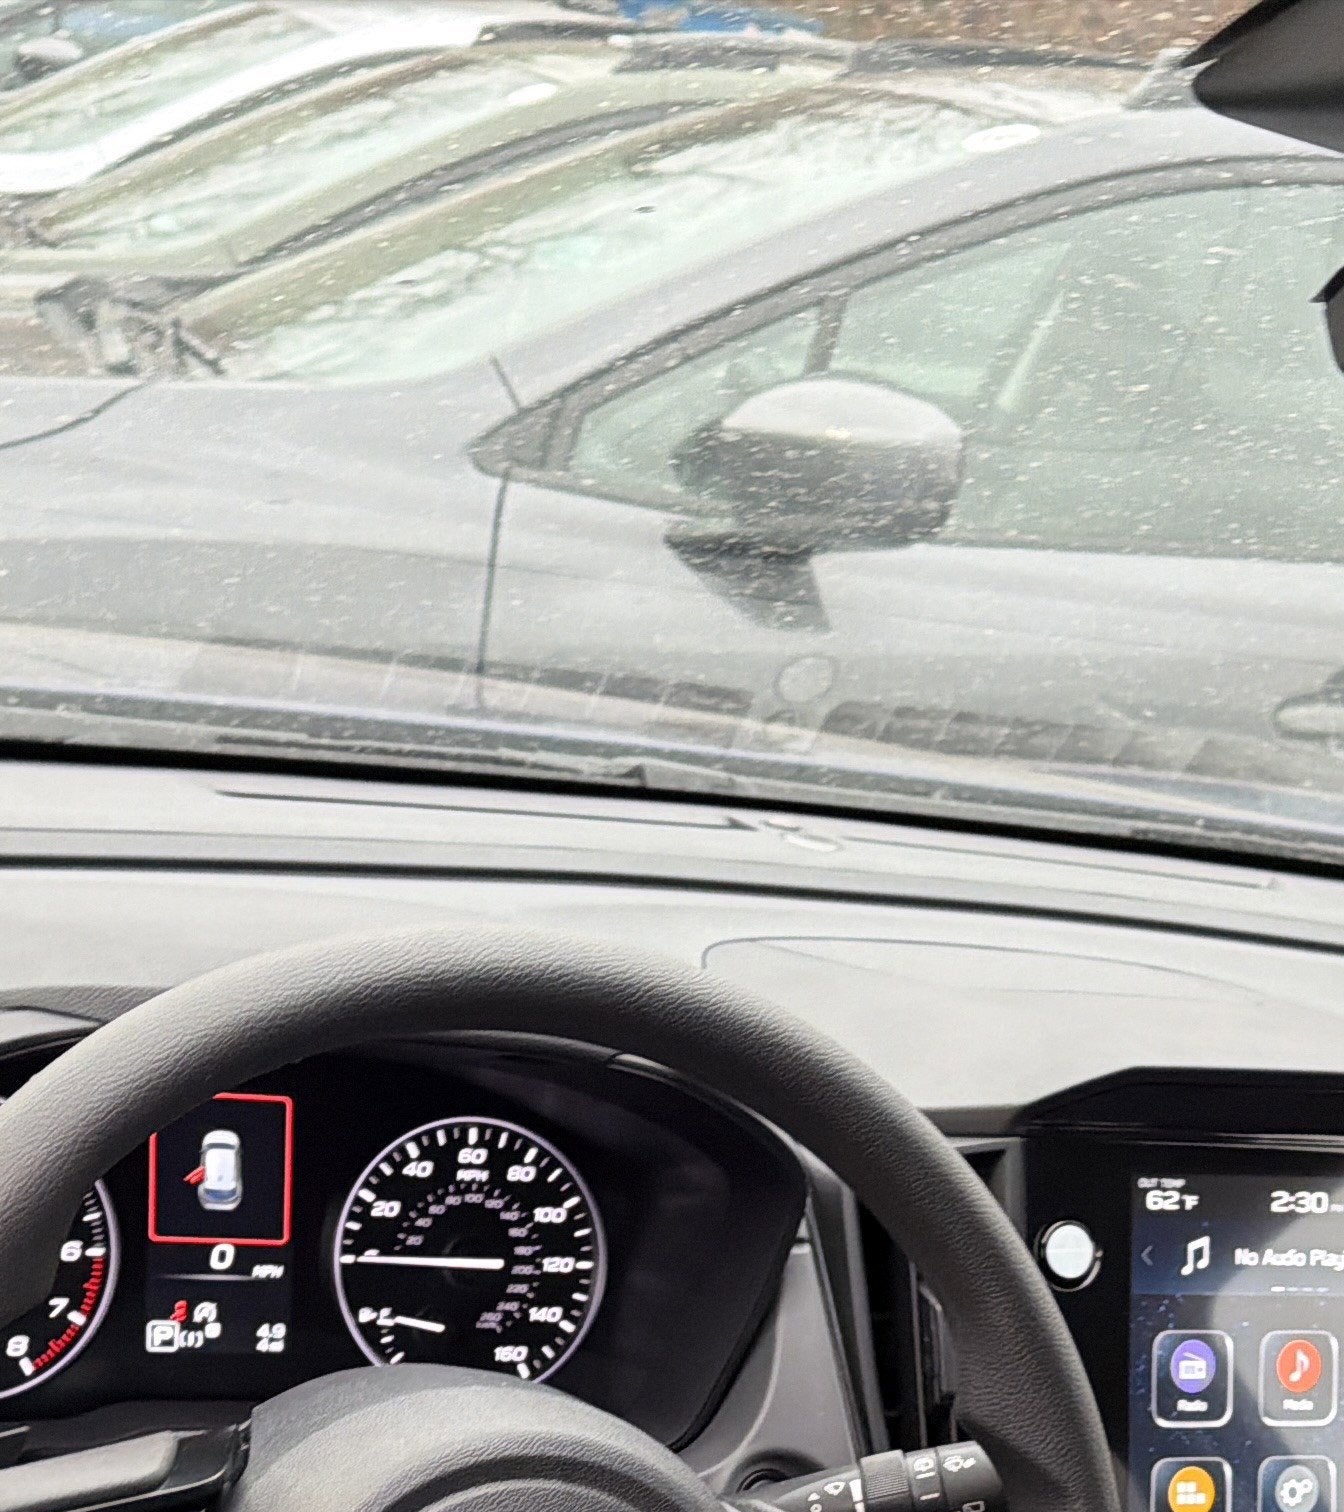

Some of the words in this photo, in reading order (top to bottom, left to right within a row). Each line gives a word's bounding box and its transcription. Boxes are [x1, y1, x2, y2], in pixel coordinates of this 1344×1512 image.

[457, 1147, 488, 1165] 60
[401, 1160, 435, 1178] 40
[455, 1169, 489, 1183] MPH
[506, 1165, 537, 1182] 80
[369, 1200, 402, 1218] 20
[1269, 1189, 1330, 1213] 2:30
[533, 1206, 568, 1224] 100
[59, 1239, 85, 1262] 6
[209, 1243, 235, 1270] 0
[1233, 1248, 1259, 1266] No
[1261, 1248, 1306, 1267] Audio
[542, 1256, 576, 1273] 120
[48, 1297, 71, 1318] 7
[528, 1306, 564, 1323] 140
